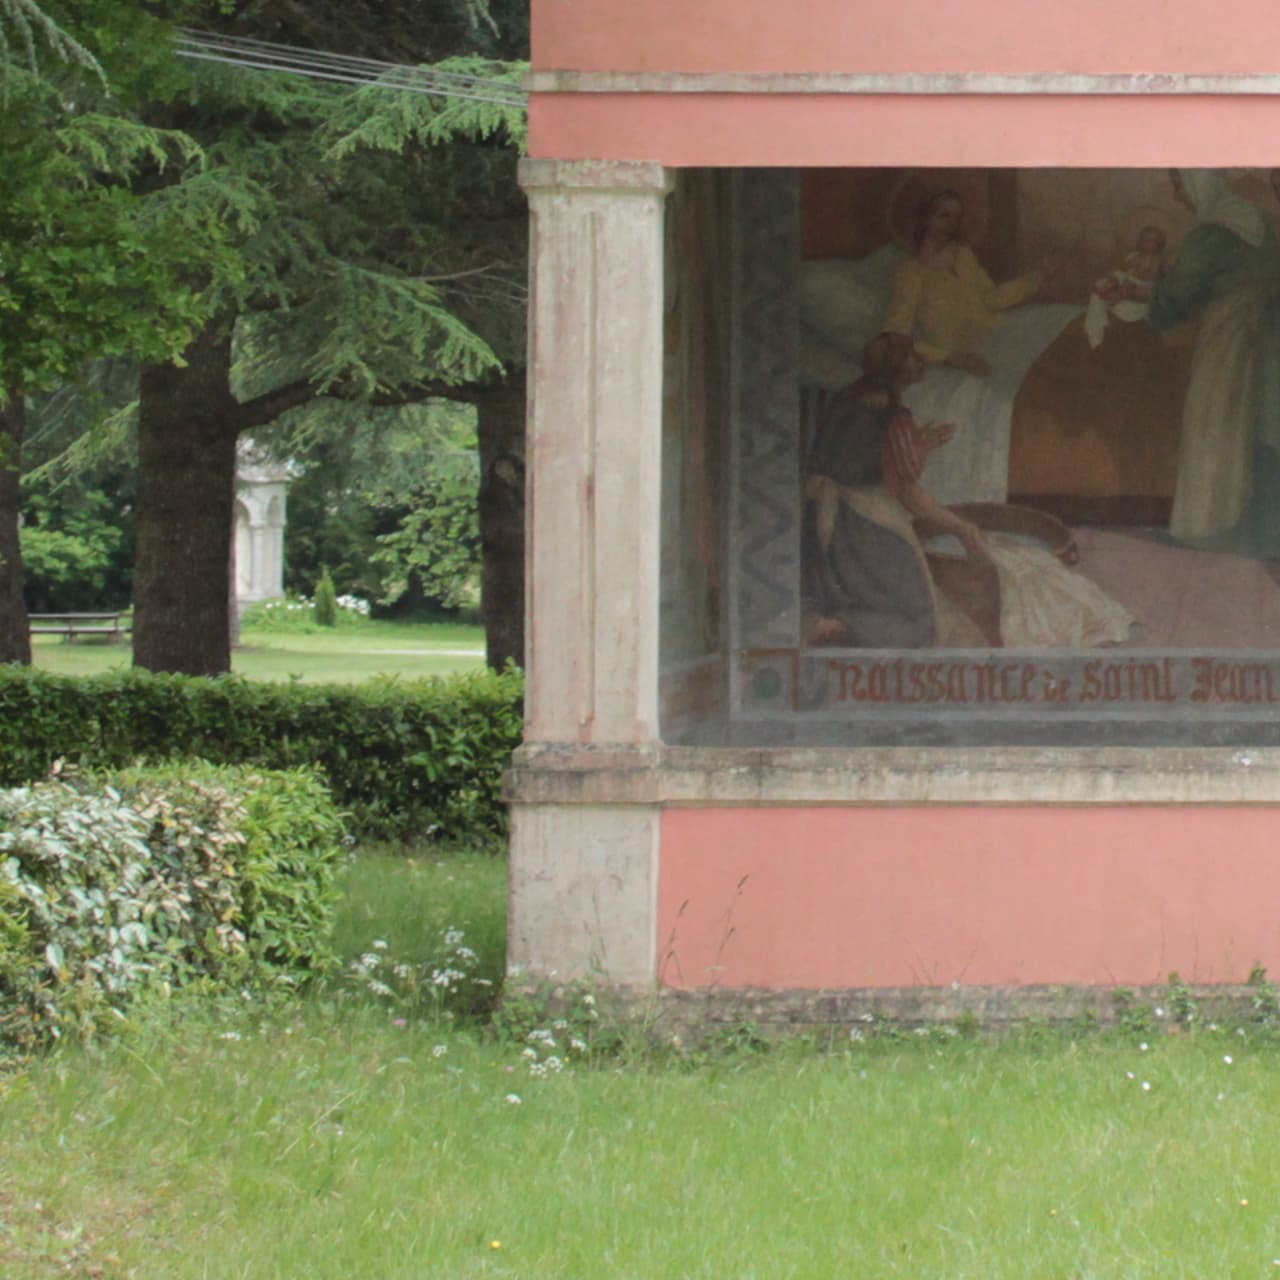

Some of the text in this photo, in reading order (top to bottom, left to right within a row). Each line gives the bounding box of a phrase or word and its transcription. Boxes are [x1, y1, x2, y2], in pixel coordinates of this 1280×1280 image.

[832, 656, 1037, 704] Naissance
[1042, 671, 1072, 703] de
[1079, 657, 1176, 704] Saint
